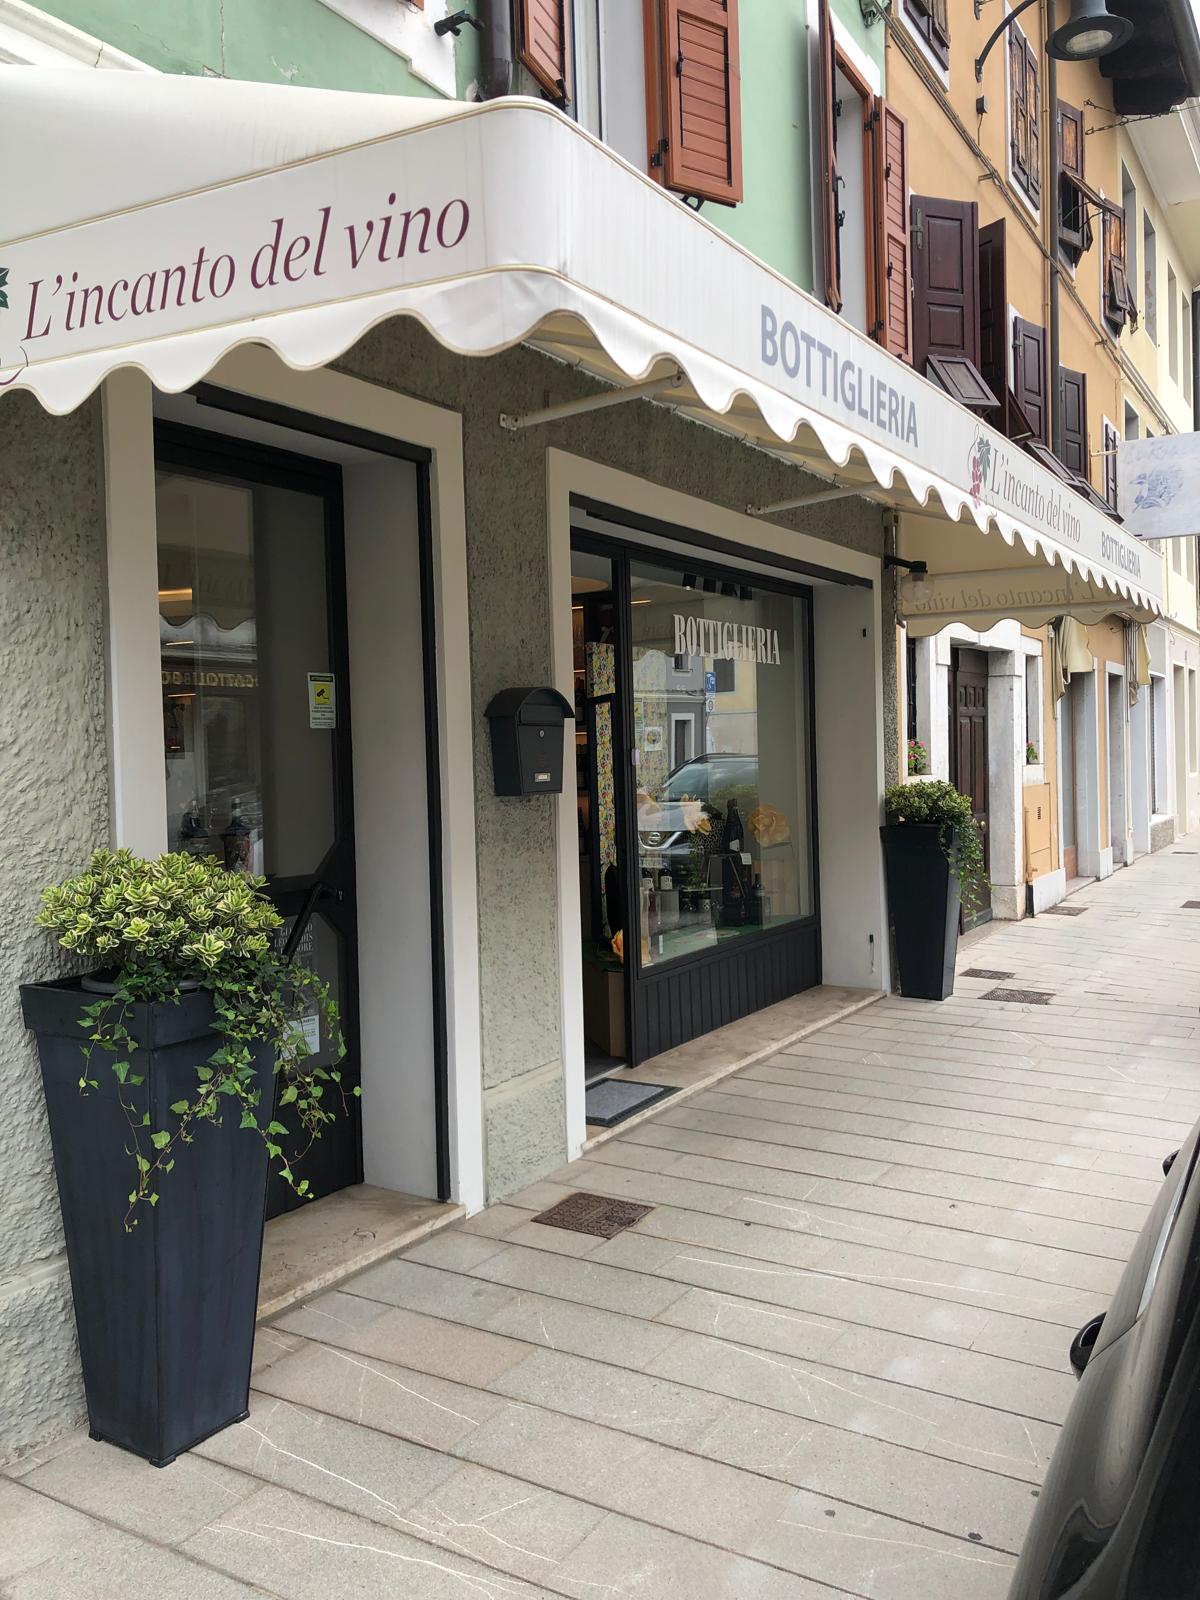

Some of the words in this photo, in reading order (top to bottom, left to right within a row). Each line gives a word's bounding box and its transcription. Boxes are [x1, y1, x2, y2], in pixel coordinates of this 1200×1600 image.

[21, 246, 236, 341] L'incanto
[251, 206, 332, 289] del
[344, 192, 470, 269] vino
[761, 304, 918, 448] BOTTIGLIERIA
[990, 448, 1044, 521] L'incanto
[1047, 488, 1061, 531] del
[1063, 503, 1081, 542] vino
[1101, 531, 1141, 580] BOTTIGLIERIA
[673, 613, 780, 665] BOTTIGLIERIA
